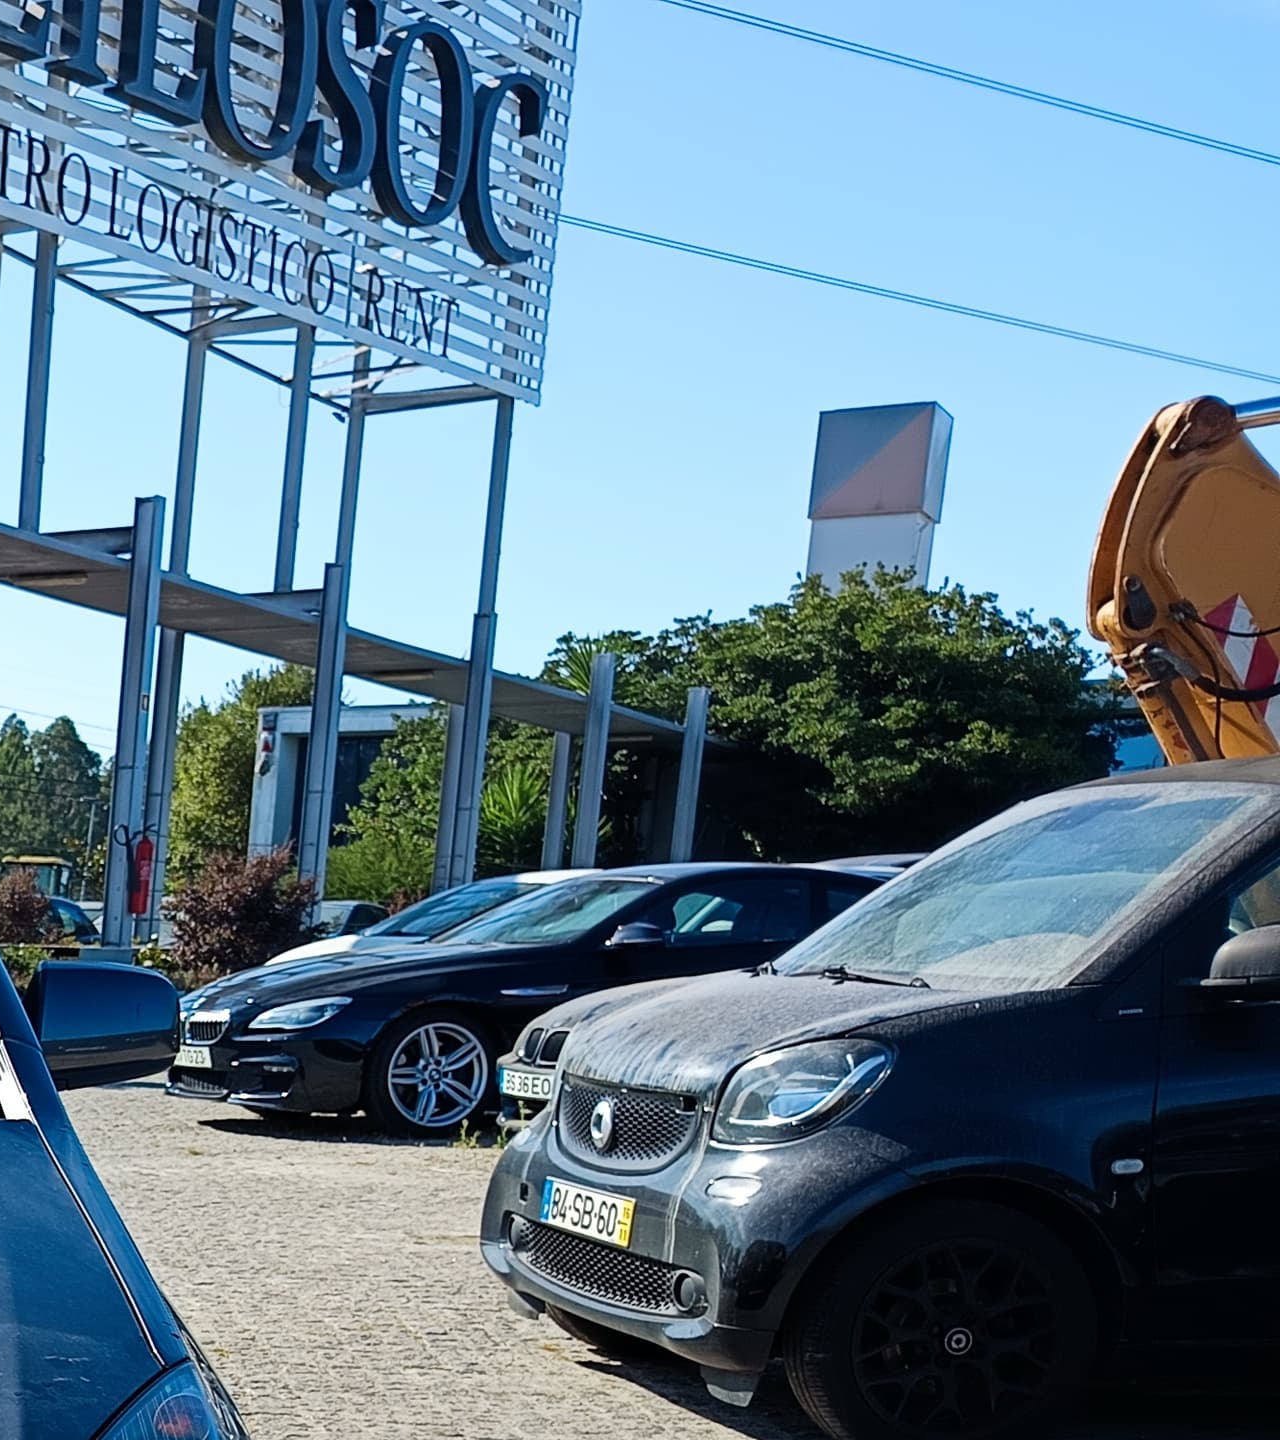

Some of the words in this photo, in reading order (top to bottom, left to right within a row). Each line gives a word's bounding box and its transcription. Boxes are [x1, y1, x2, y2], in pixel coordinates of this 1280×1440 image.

[104, 165, 334, 315] LOGÍSTICO
[359, 266, 460, 358] RENT
[551, 1187, 618, 1237] 84·SB·60
